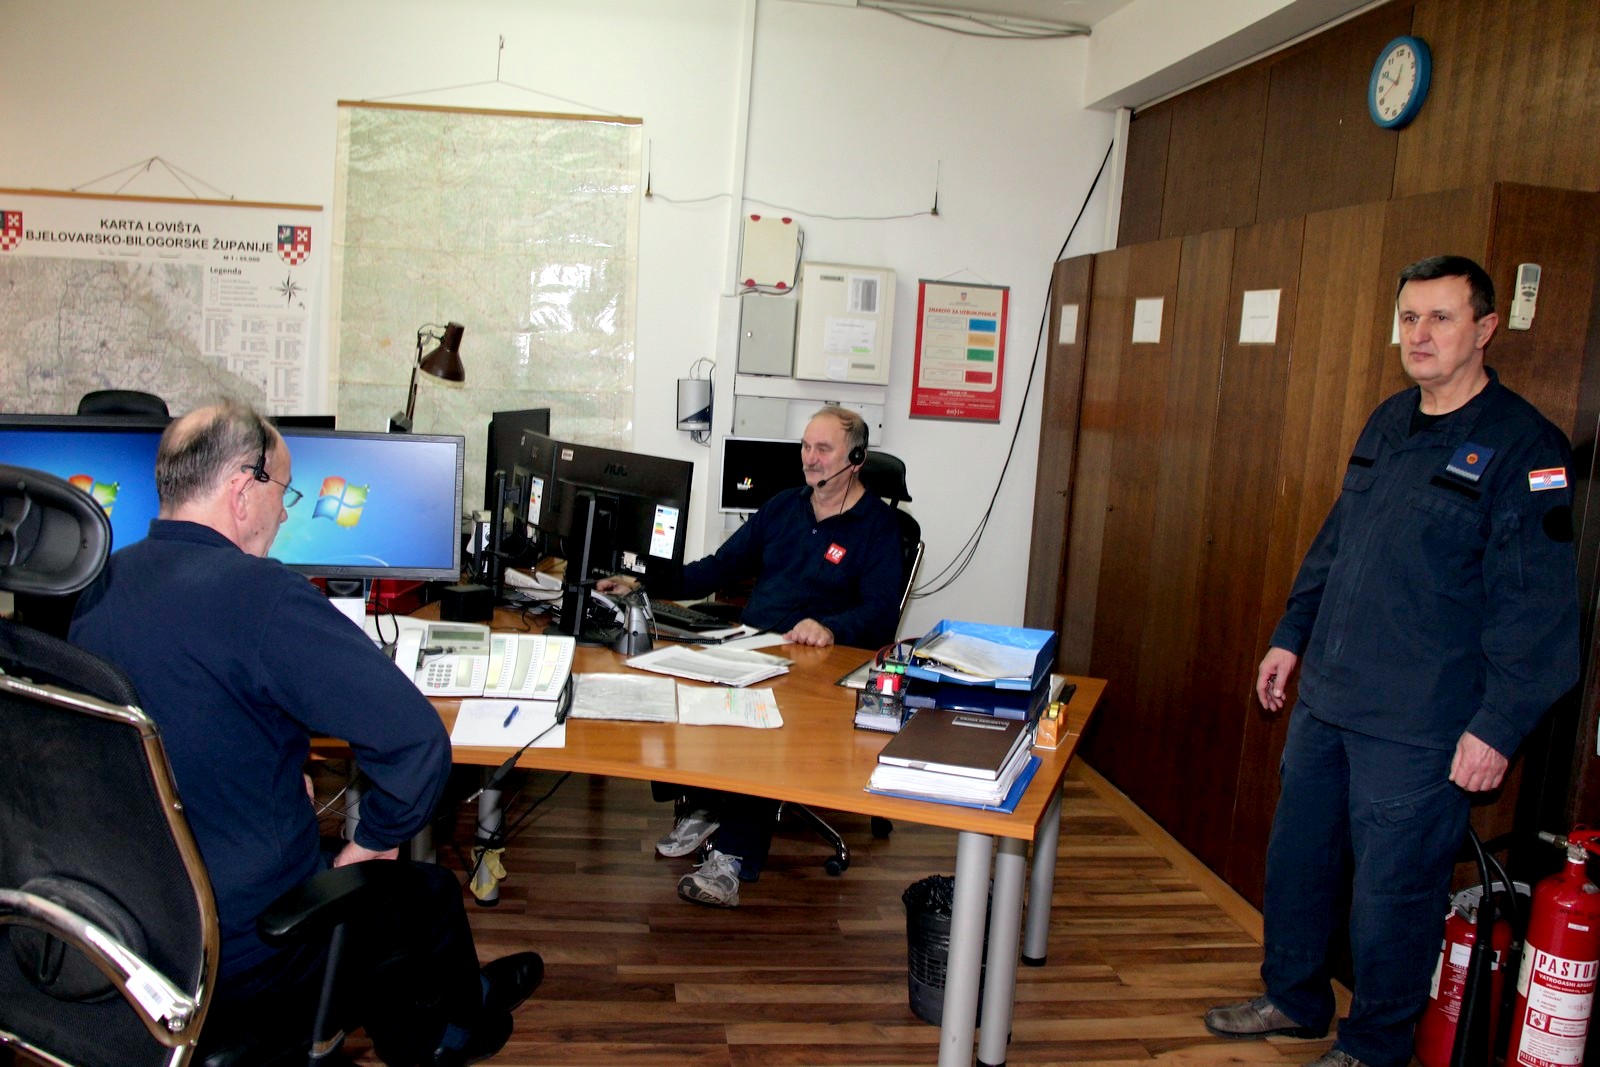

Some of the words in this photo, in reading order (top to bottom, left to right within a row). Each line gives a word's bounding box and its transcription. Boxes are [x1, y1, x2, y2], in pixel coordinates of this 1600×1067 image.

[1396, 48, 1405, 57] 12
[100, 219, 143, 231] KARTA
[148, 220, 201, 234] LOVIŠTA
[26, 230, 208, 250] BJELOVARSKO-BILOGORSKE
[212, 237, 273, 253] ŽUPANIJE
[210, 266, 242, 276] Legenda
[828, 546, 843, 559] 112
[1538, 973, 1576, 987] VATROGASNI
